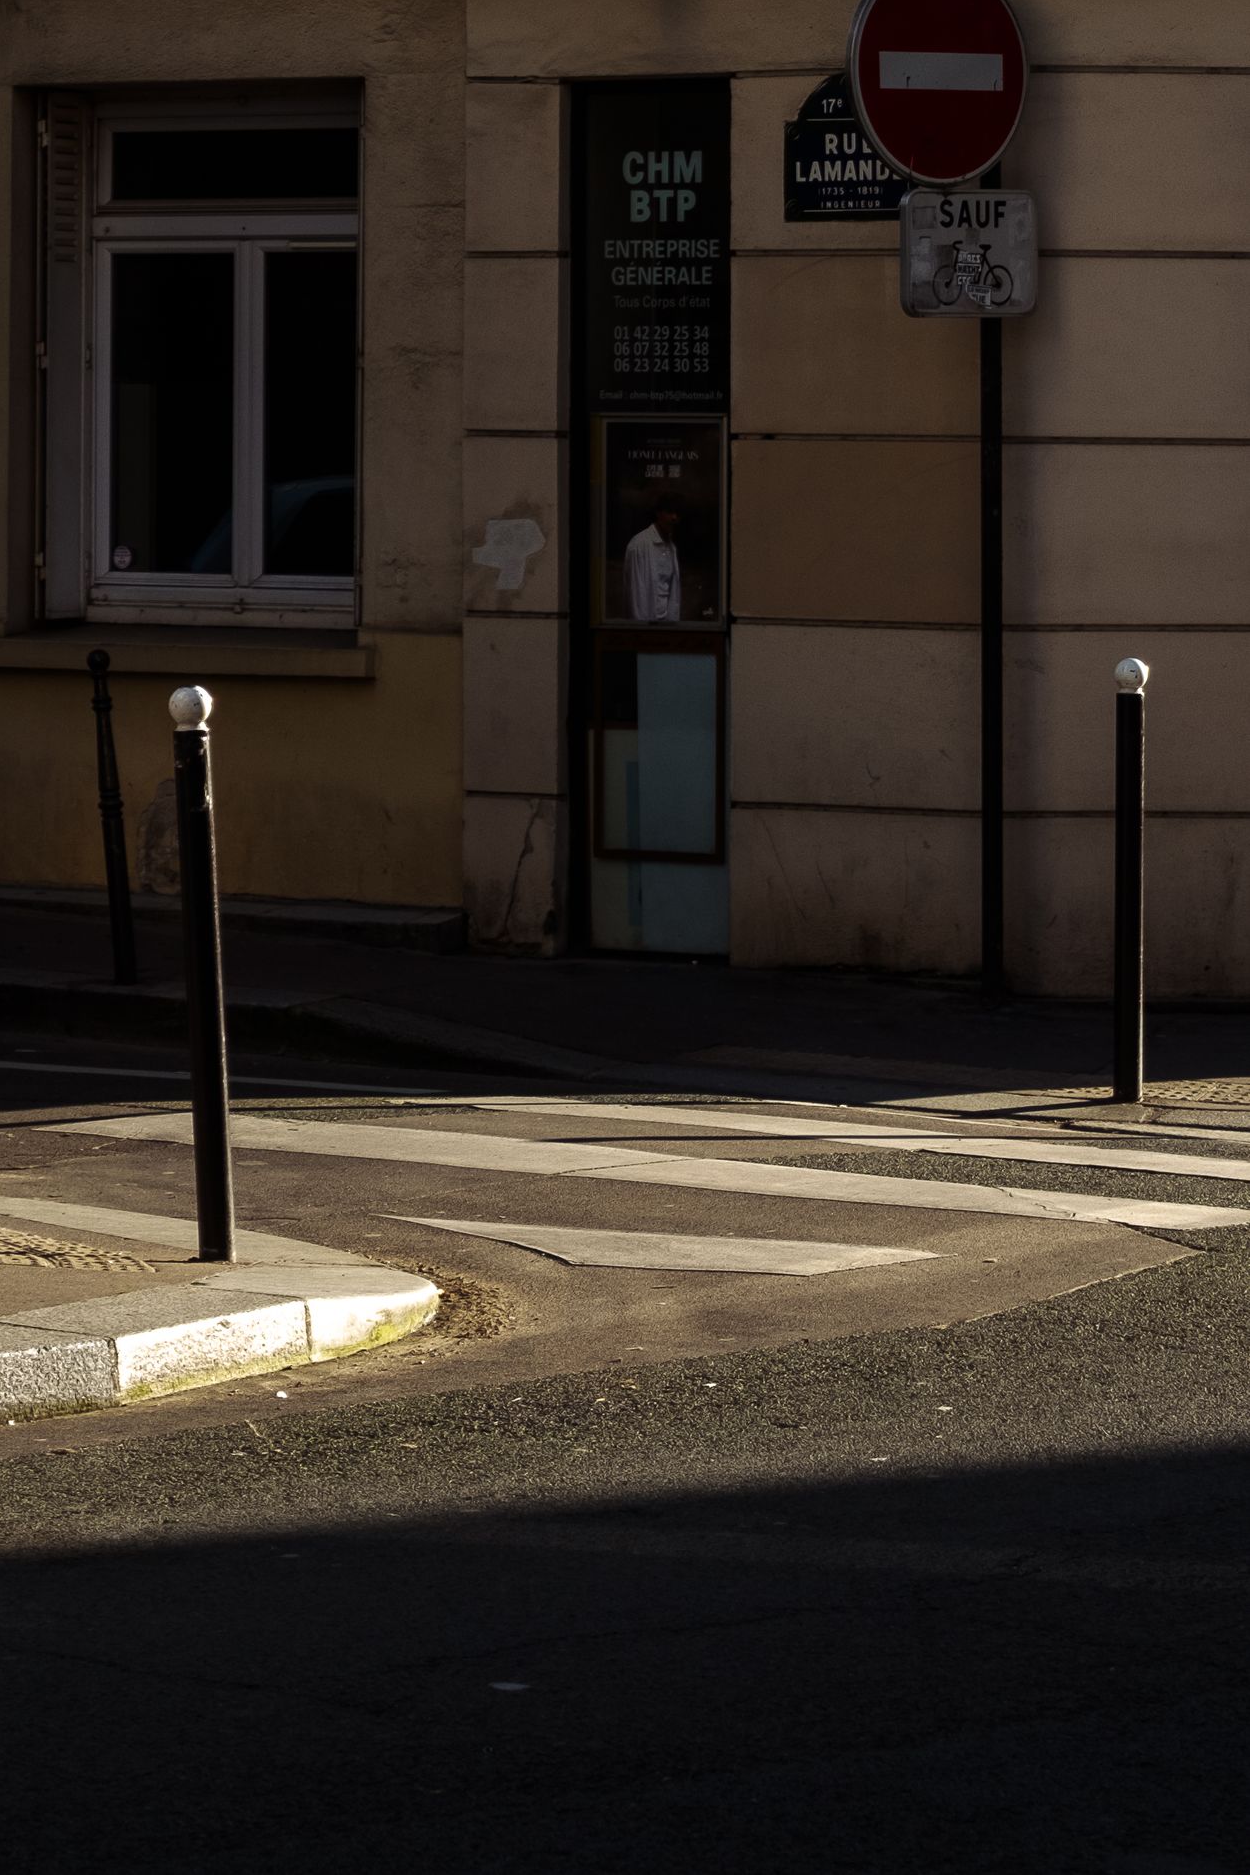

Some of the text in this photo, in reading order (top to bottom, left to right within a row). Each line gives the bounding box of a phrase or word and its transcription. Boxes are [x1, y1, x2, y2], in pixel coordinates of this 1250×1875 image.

[622, 150, 703, 185] CHM
[795, 159, 903, 183] LAMAND
[630, 189, 697, 223] BTP
[939, 199, 1007, 229] SAUF
[603, 238, 721, 260] ENTREPRISE
[611, 261, 713, 286] GÉNÉRALE
[613, 295, 640, 308] Tous
[642, 295, 676, 311] Corps
[614, 325, 710, 340] 01 42 29 25 34
[614, 341, 710, 356] 06 07 32 25 48
[614, 358, 710, 373] 06 23 24 30 53
